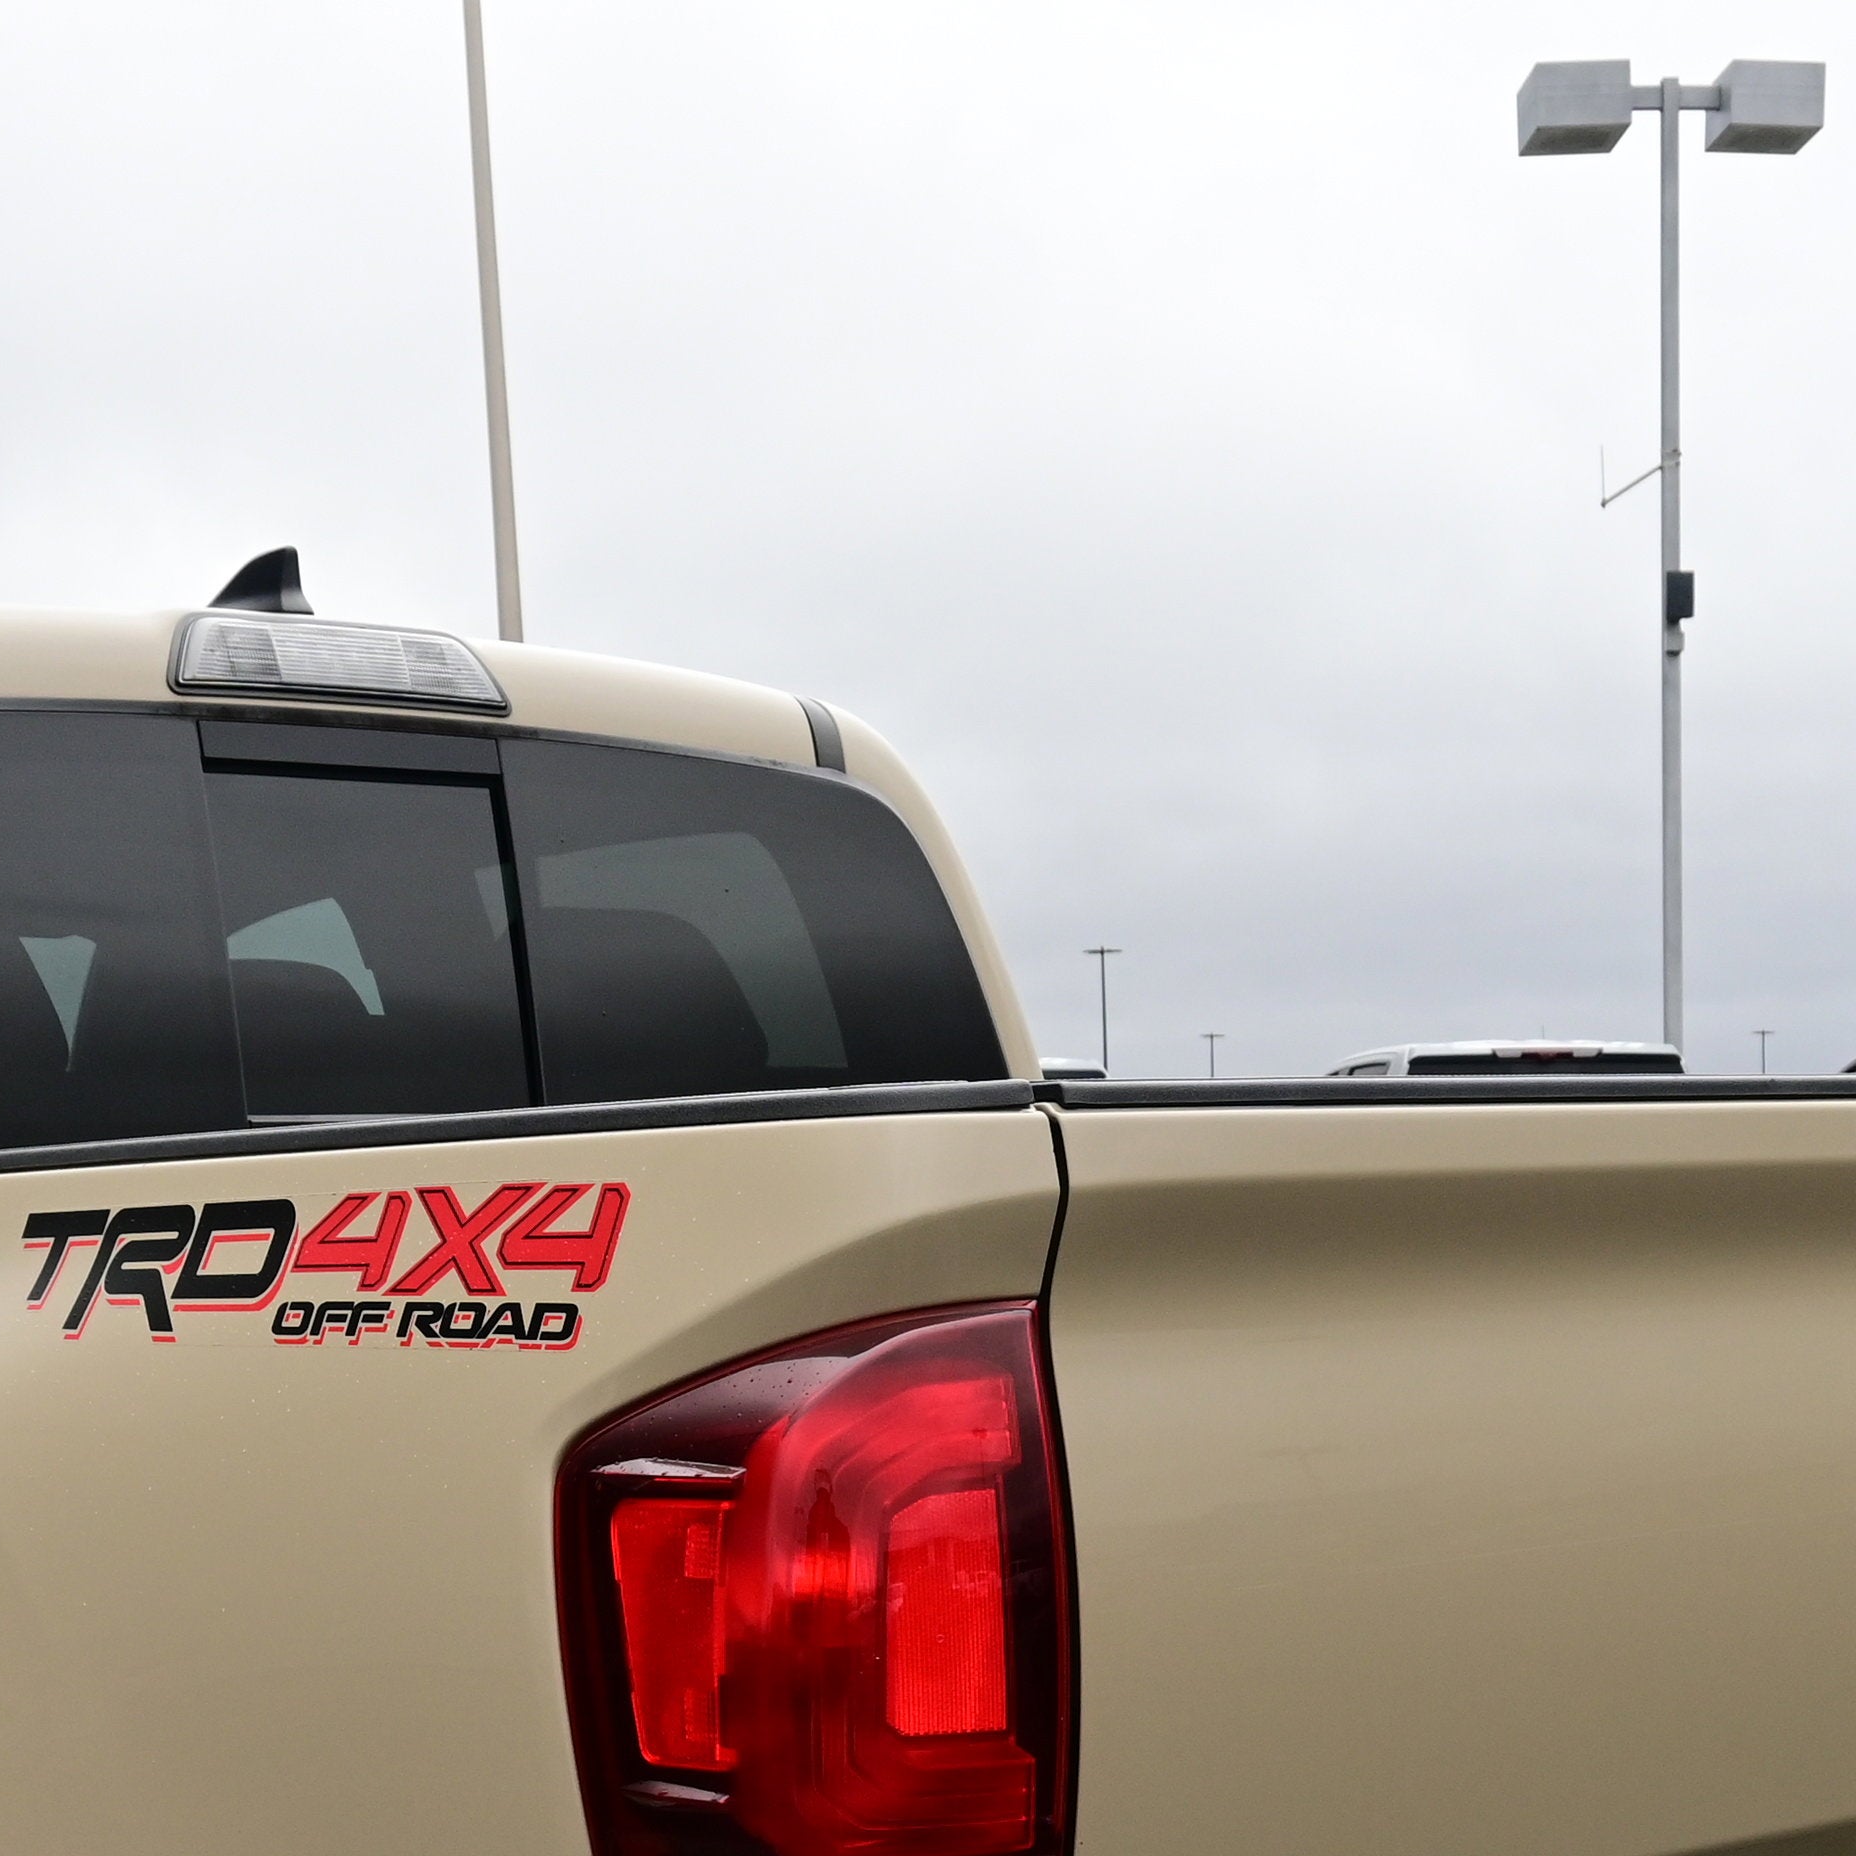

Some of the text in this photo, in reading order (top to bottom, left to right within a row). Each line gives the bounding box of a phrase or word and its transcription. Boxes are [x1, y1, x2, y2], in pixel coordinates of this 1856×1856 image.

[22, 1199, 297, 1342] TRD
[271, 1301, 583, 1350] OFF ROAD
